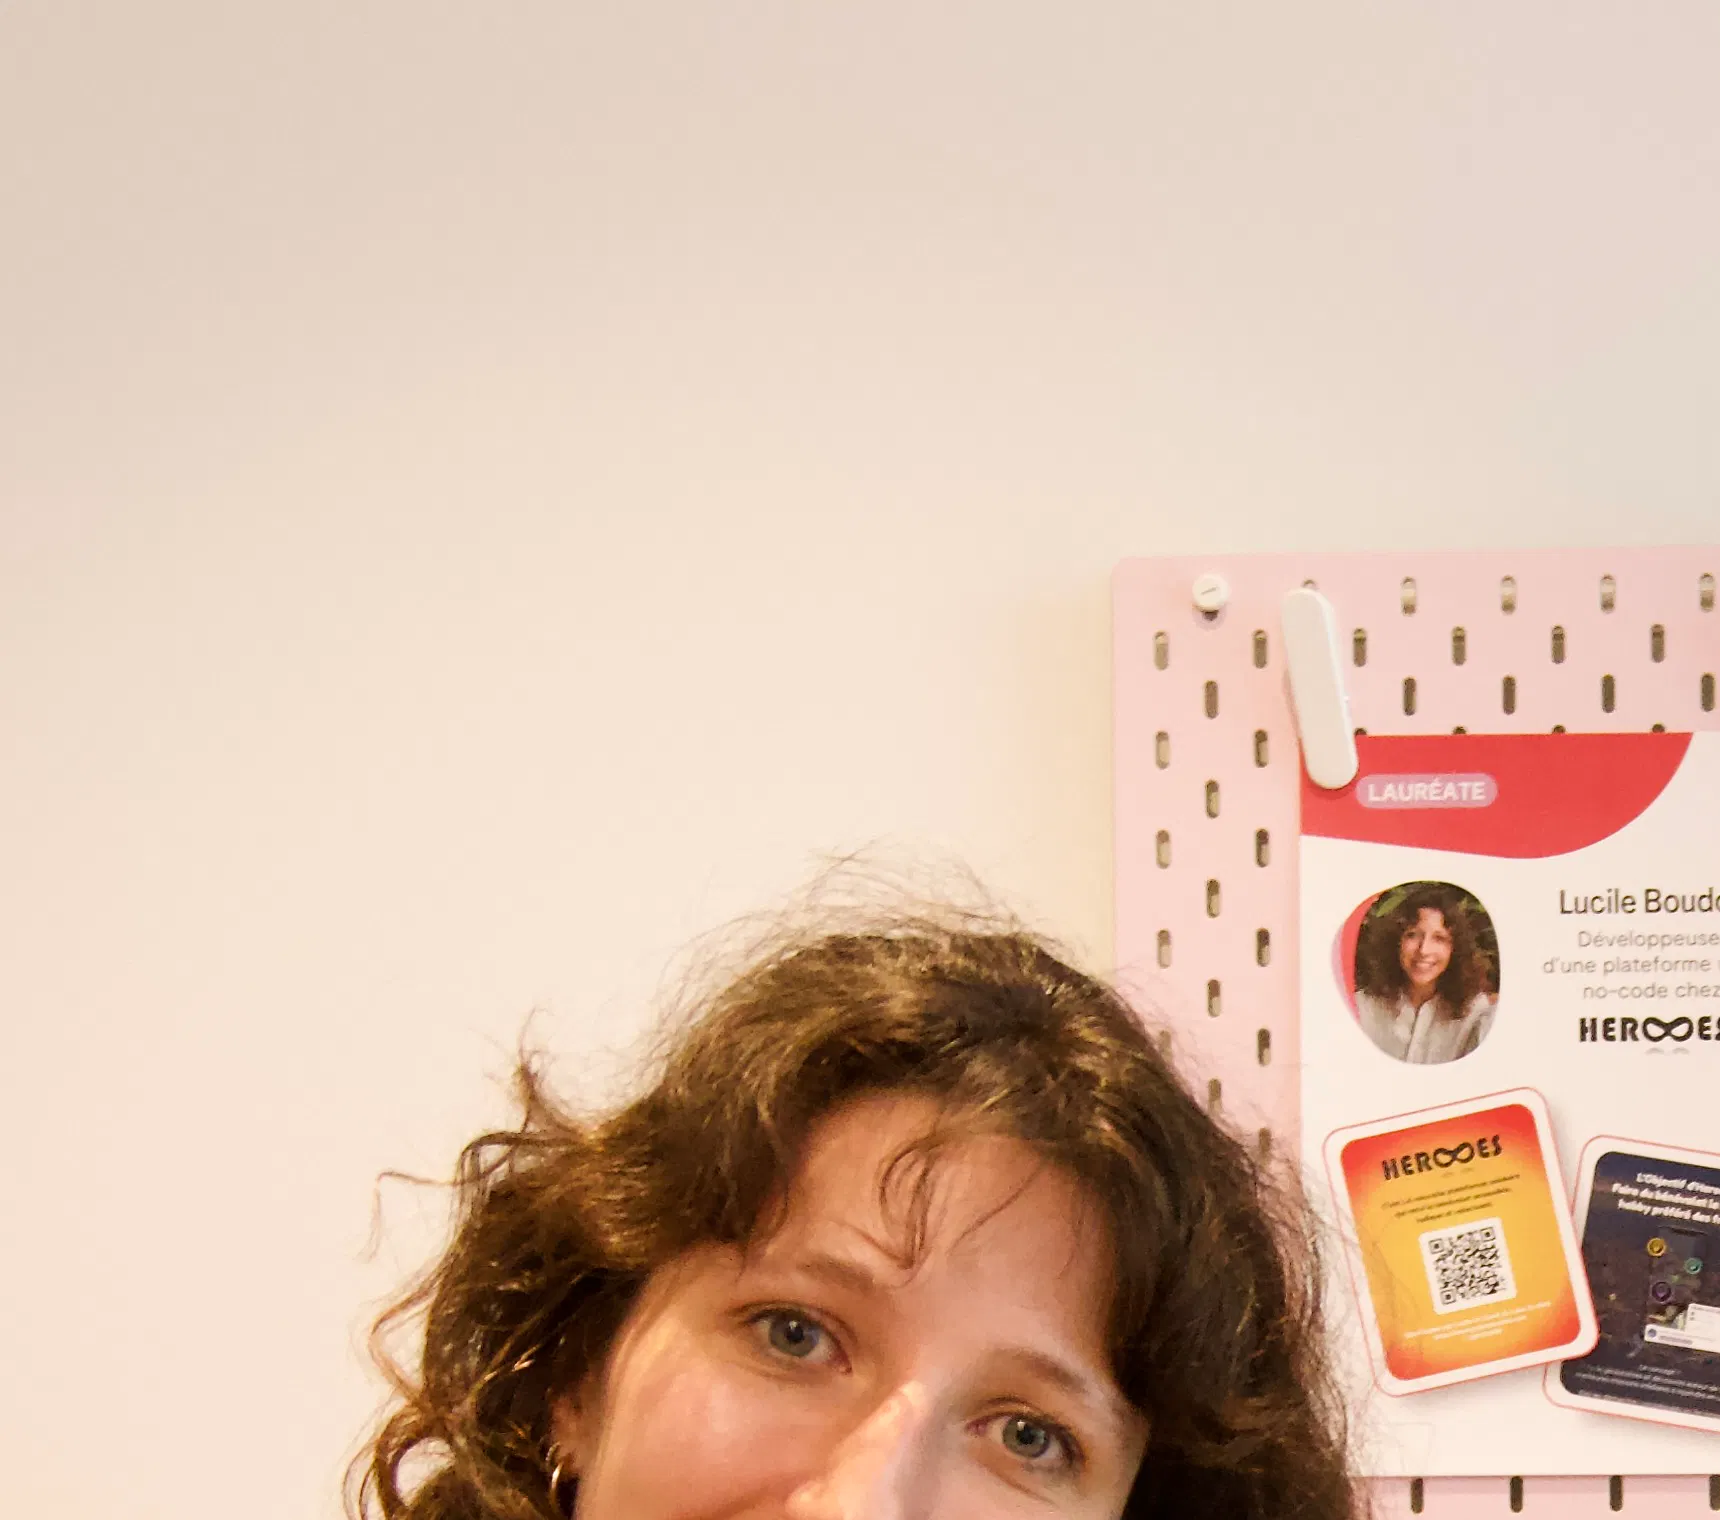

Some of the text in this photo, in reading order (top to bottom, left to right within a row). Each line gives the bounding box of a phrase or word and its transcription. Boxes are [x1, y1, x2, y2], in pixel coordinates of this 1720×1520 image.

[1367, 778, 1486, 802] LAURÉATE
[1560, 888, 1637, 914] Lucile
[1577, 930, 1720, 950] Développeuse
[1543, 957, 1596, 974] d'une
[1603, 957, 1711, 976] plateforme
[1583, 982, 1668, 999] no-code
